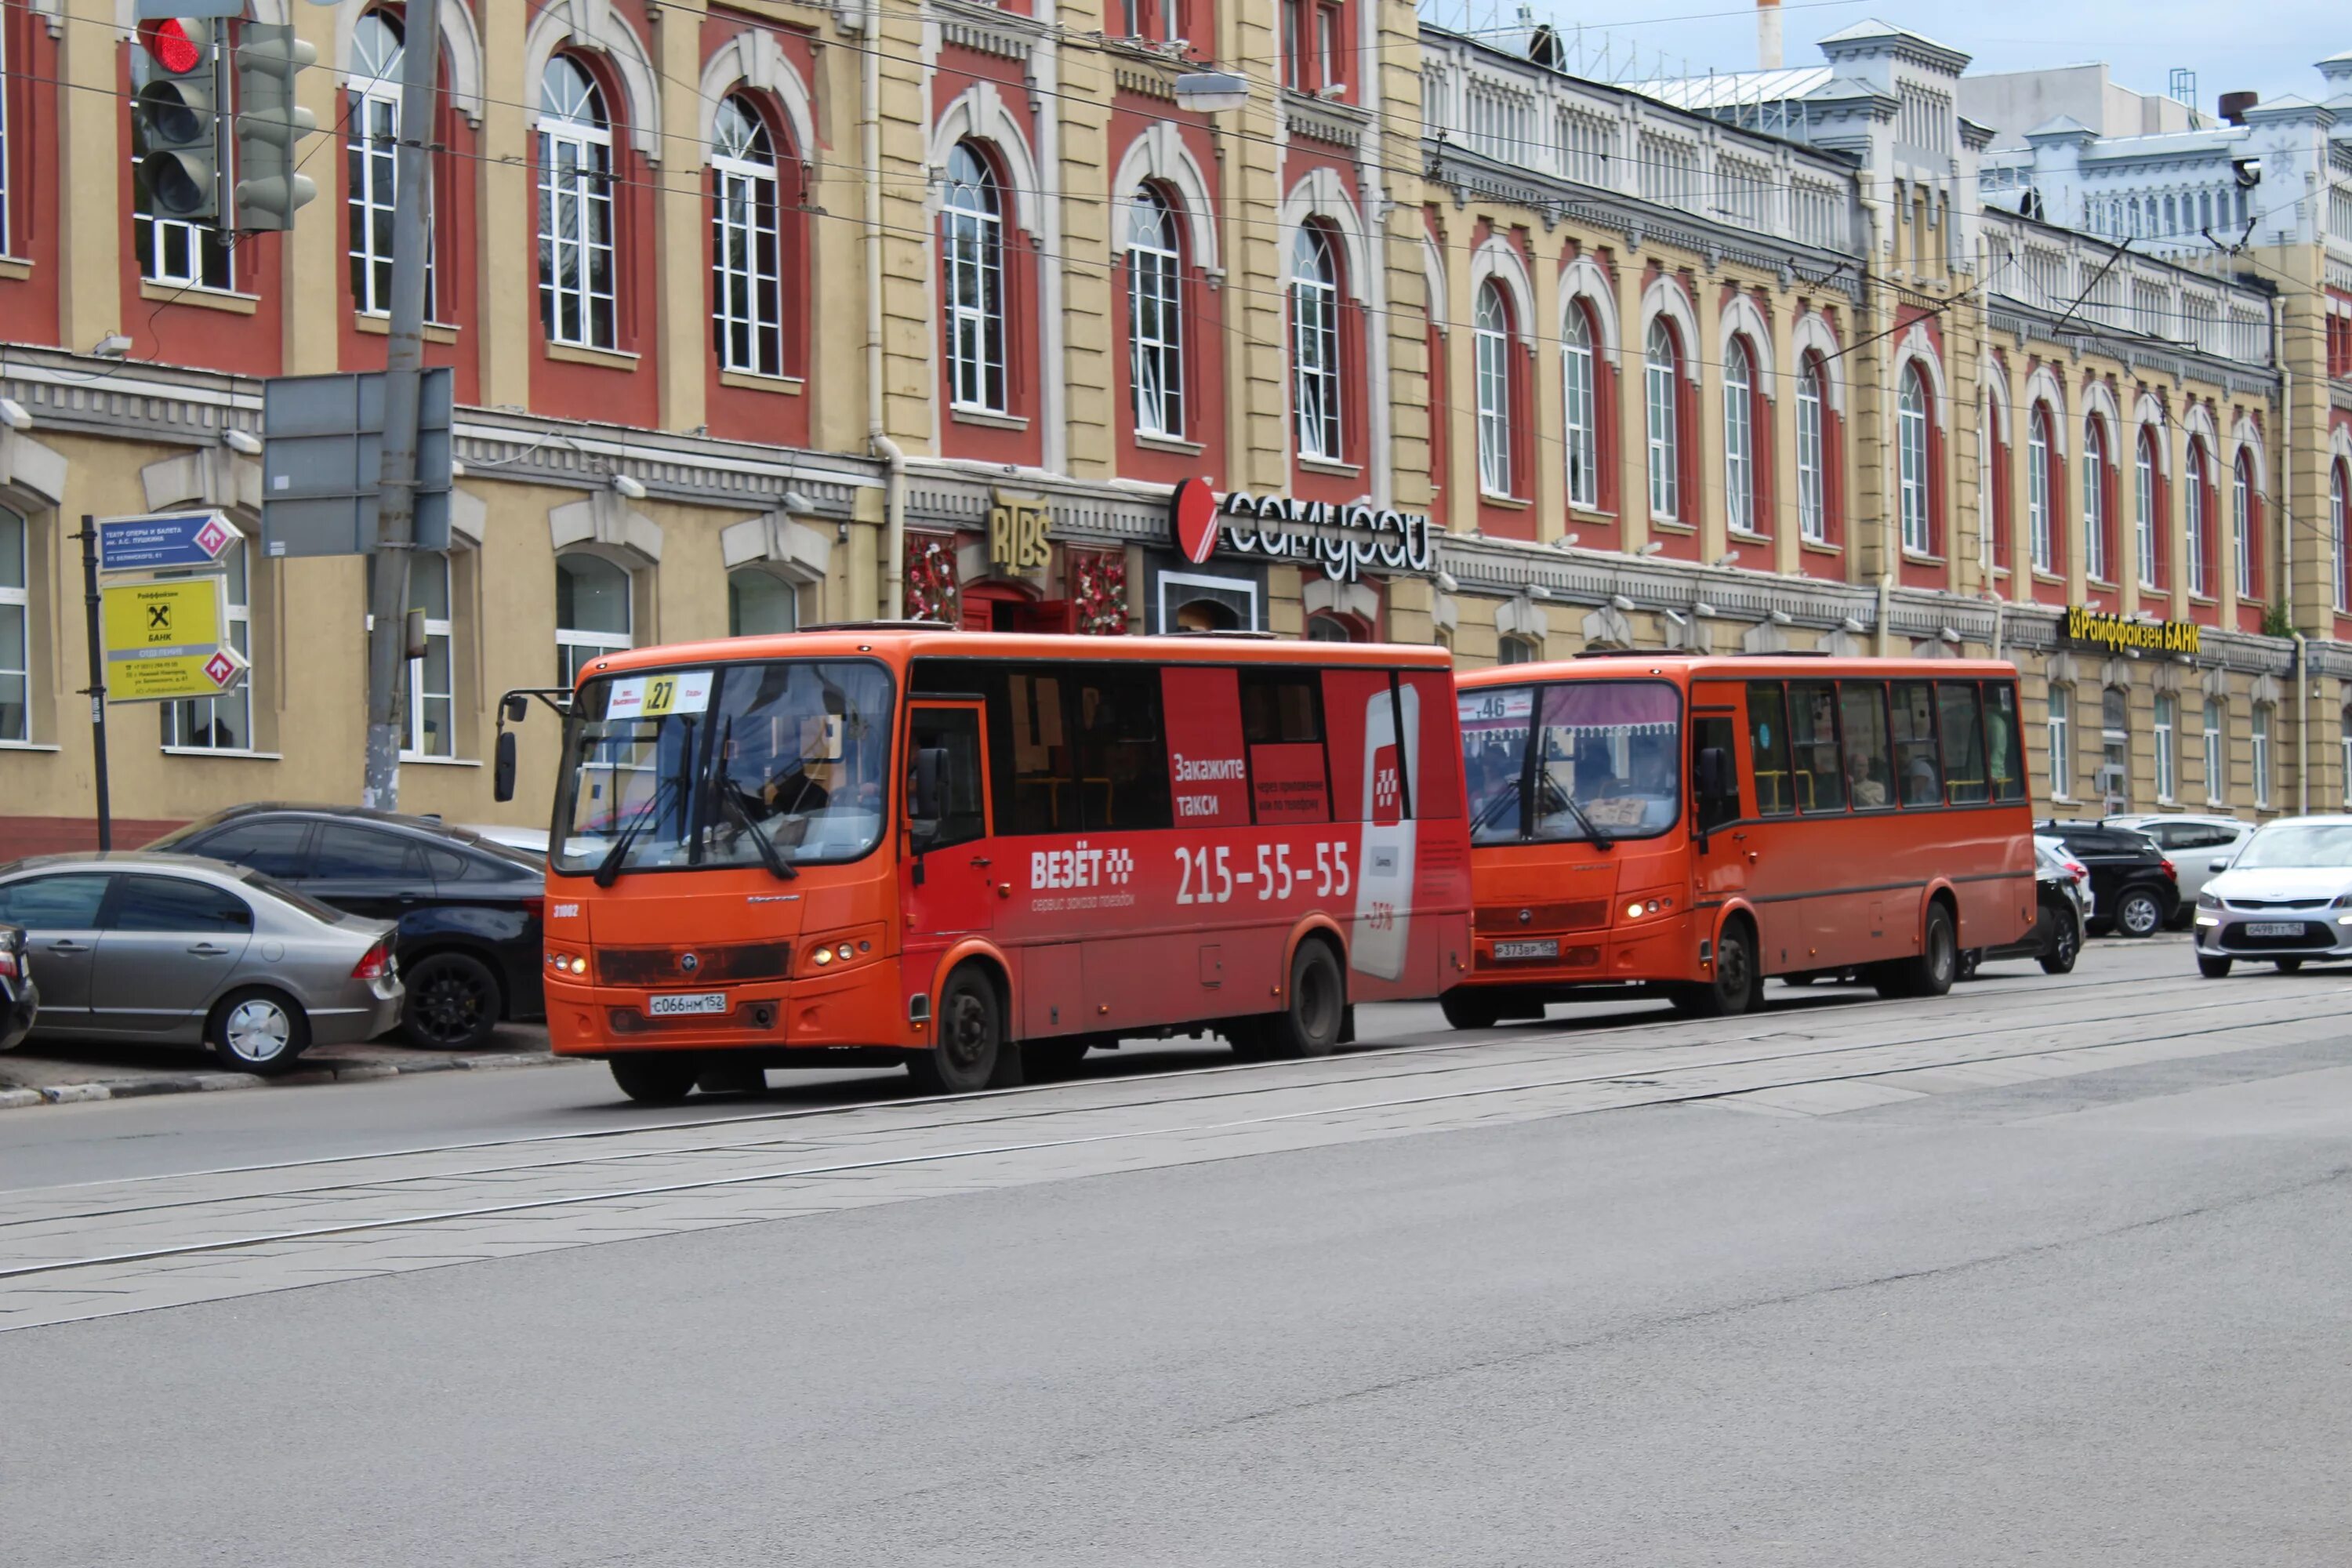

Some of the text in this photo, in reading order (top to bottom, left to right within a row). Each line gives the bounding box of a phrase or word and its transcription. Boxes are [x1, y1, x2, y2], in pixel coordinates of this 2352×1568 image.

[2165, 621, 2200, 653] БАНК
[1174, 753, 1245, 782] Закажите
[1178, 795, 1219, 816] такси
[1031, 840, 1103, 890] ВЕЗЁТ
[1174, 841, 1350, 904] 215-55-55
